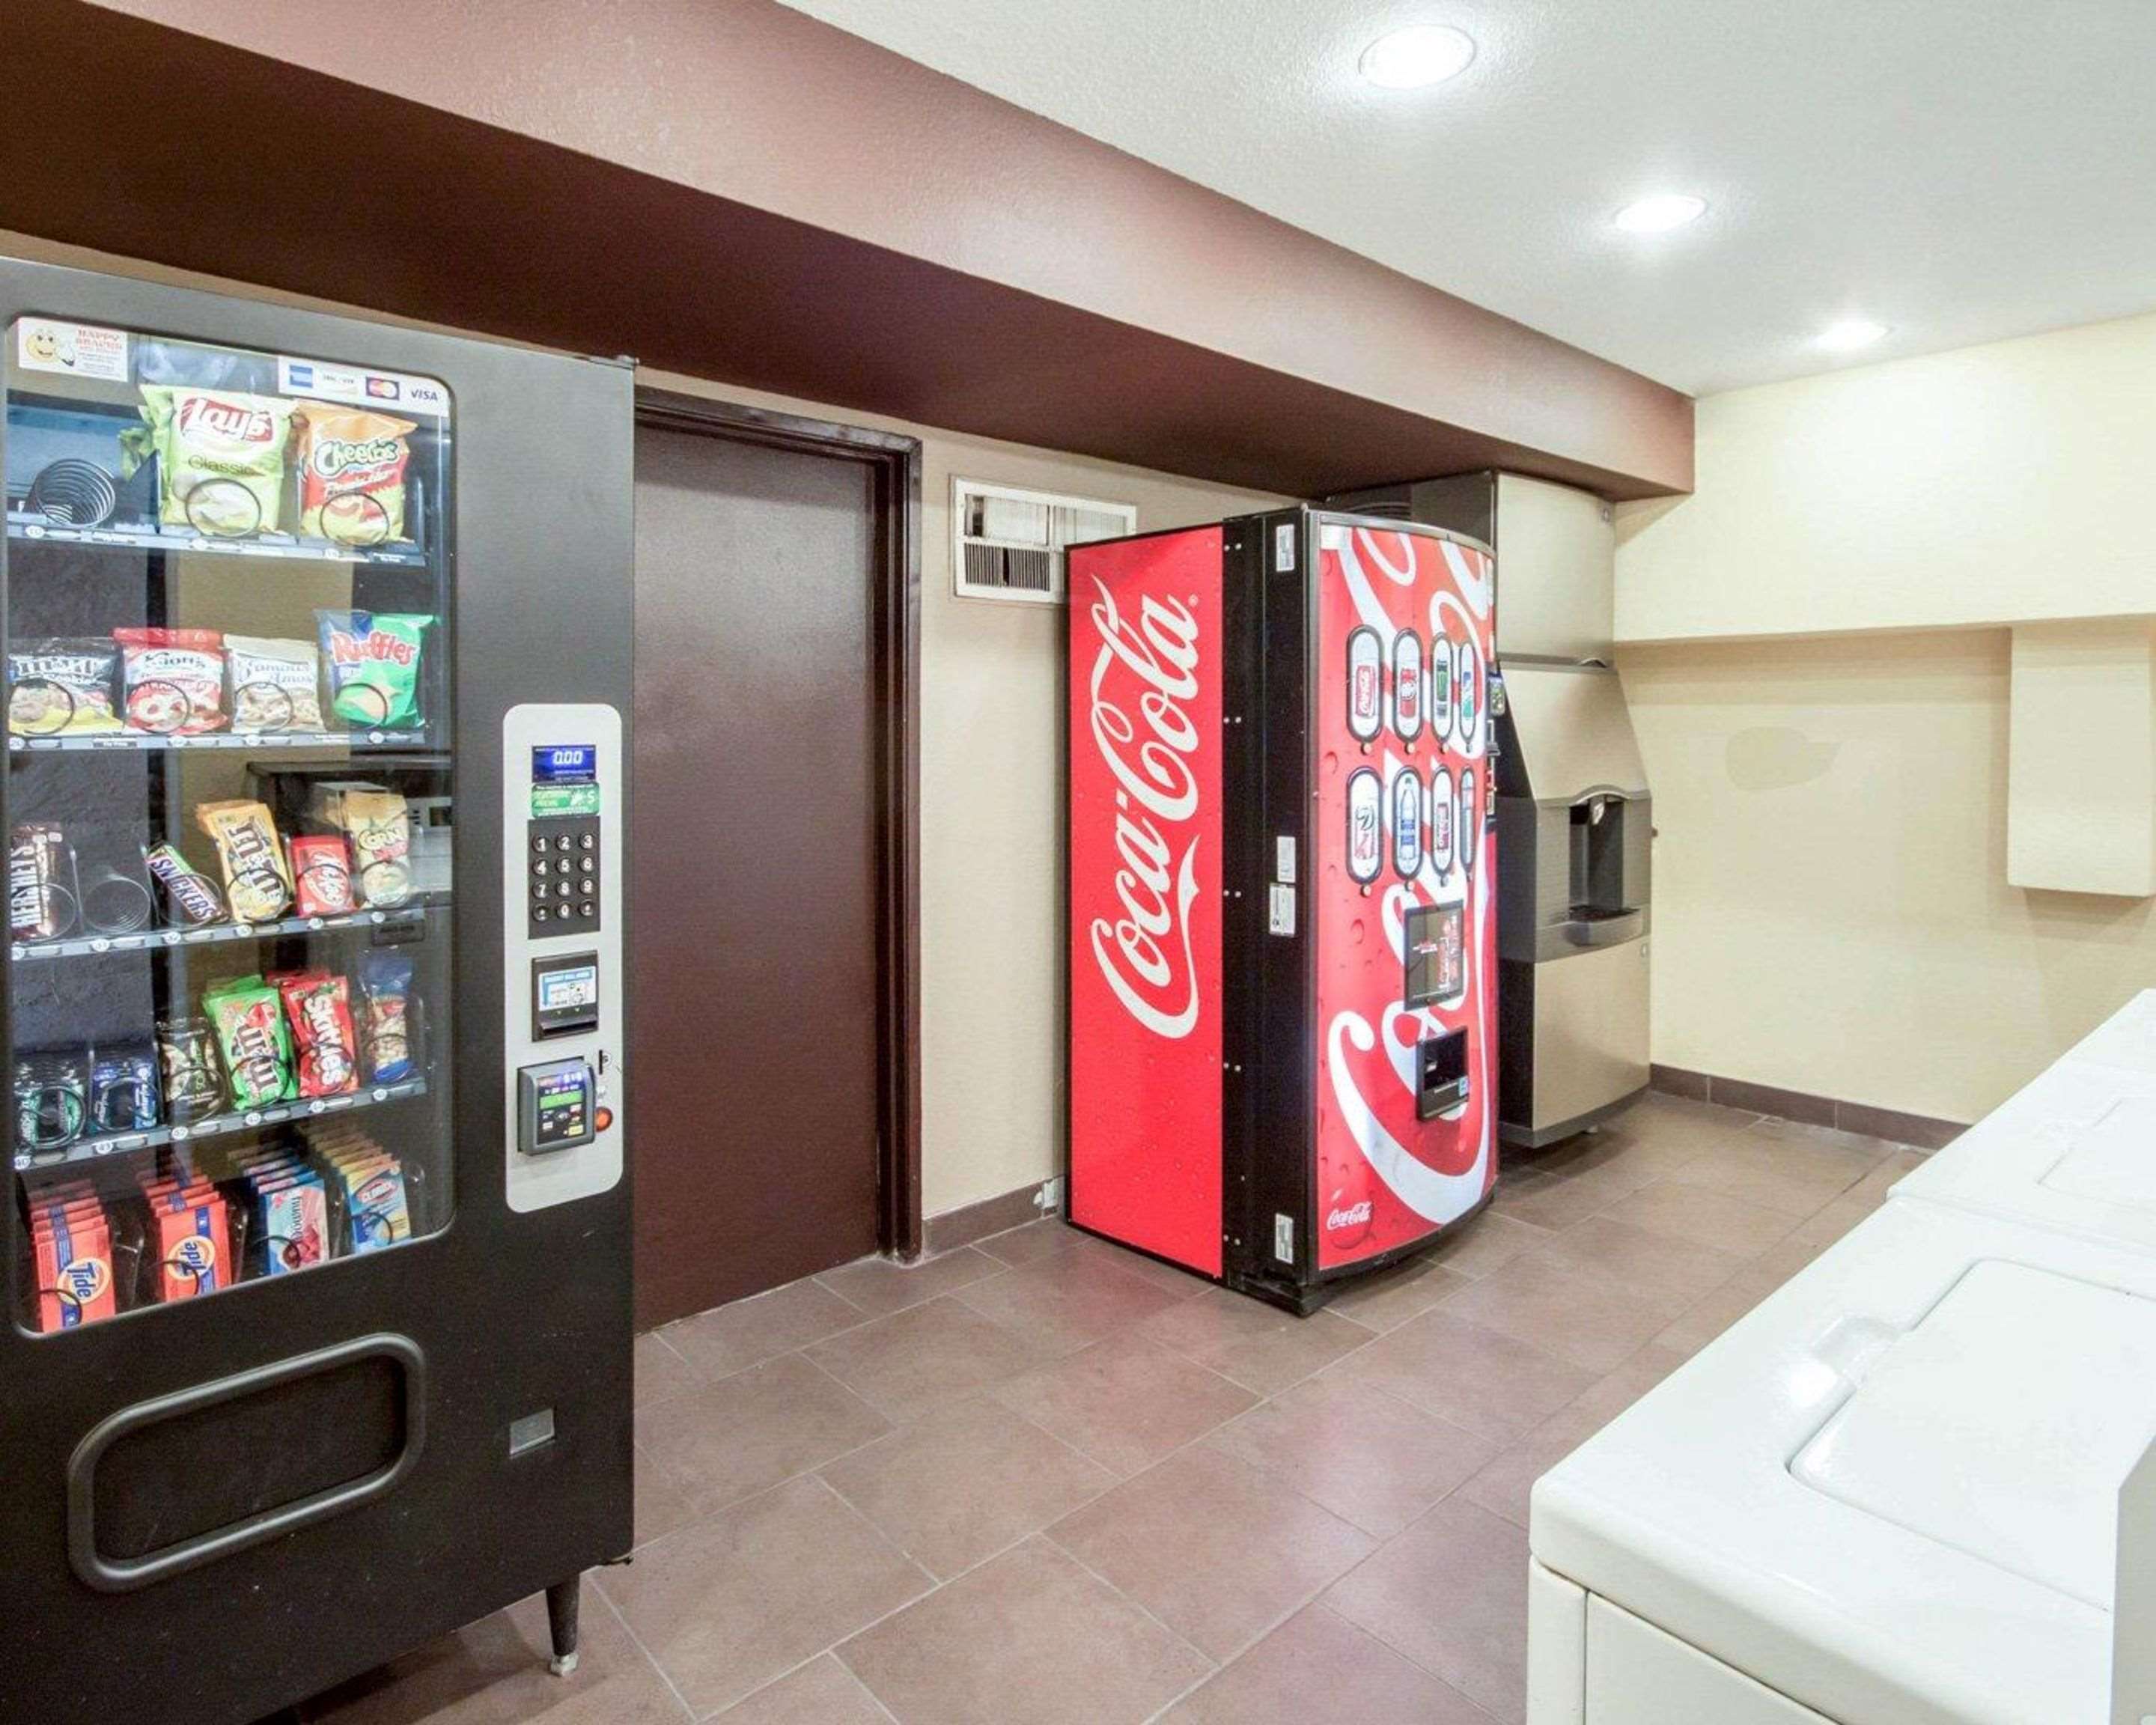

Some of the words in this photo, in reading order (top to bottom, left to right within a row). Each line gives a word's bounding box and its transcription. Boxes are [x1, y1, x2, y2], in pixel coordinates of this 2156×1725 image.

[411, 389, 439, 402] VISA
[189, 454, 258, 475] Classic
[314, 439, 399, 476] Cheetos
[330, 630, 418, 666] Ruffles
[1090, 574, 1201, 1039] Coca-Cola
[538, 837, 547, 852] 1
[561, 836, 570, 851] 2
[583, 834, 593, 849] 3
[537, 860, 547, 875] 4
[561, 859, 570, 873] 5
[583, 857, 593, 871] 6
[152, 857, 215, 922] SNICKERS
[538, 883, 547, 898] 7
[561, 881, 570, 896] 8
[583, 879, 593, 894] 9
[560, 904, 569, 919] 0
[1327, 1200, 1373, 1230] Coca-Cola
[179, 1242, 207, 1277] Tide
[67, 1261, 96, 1298] Tide
